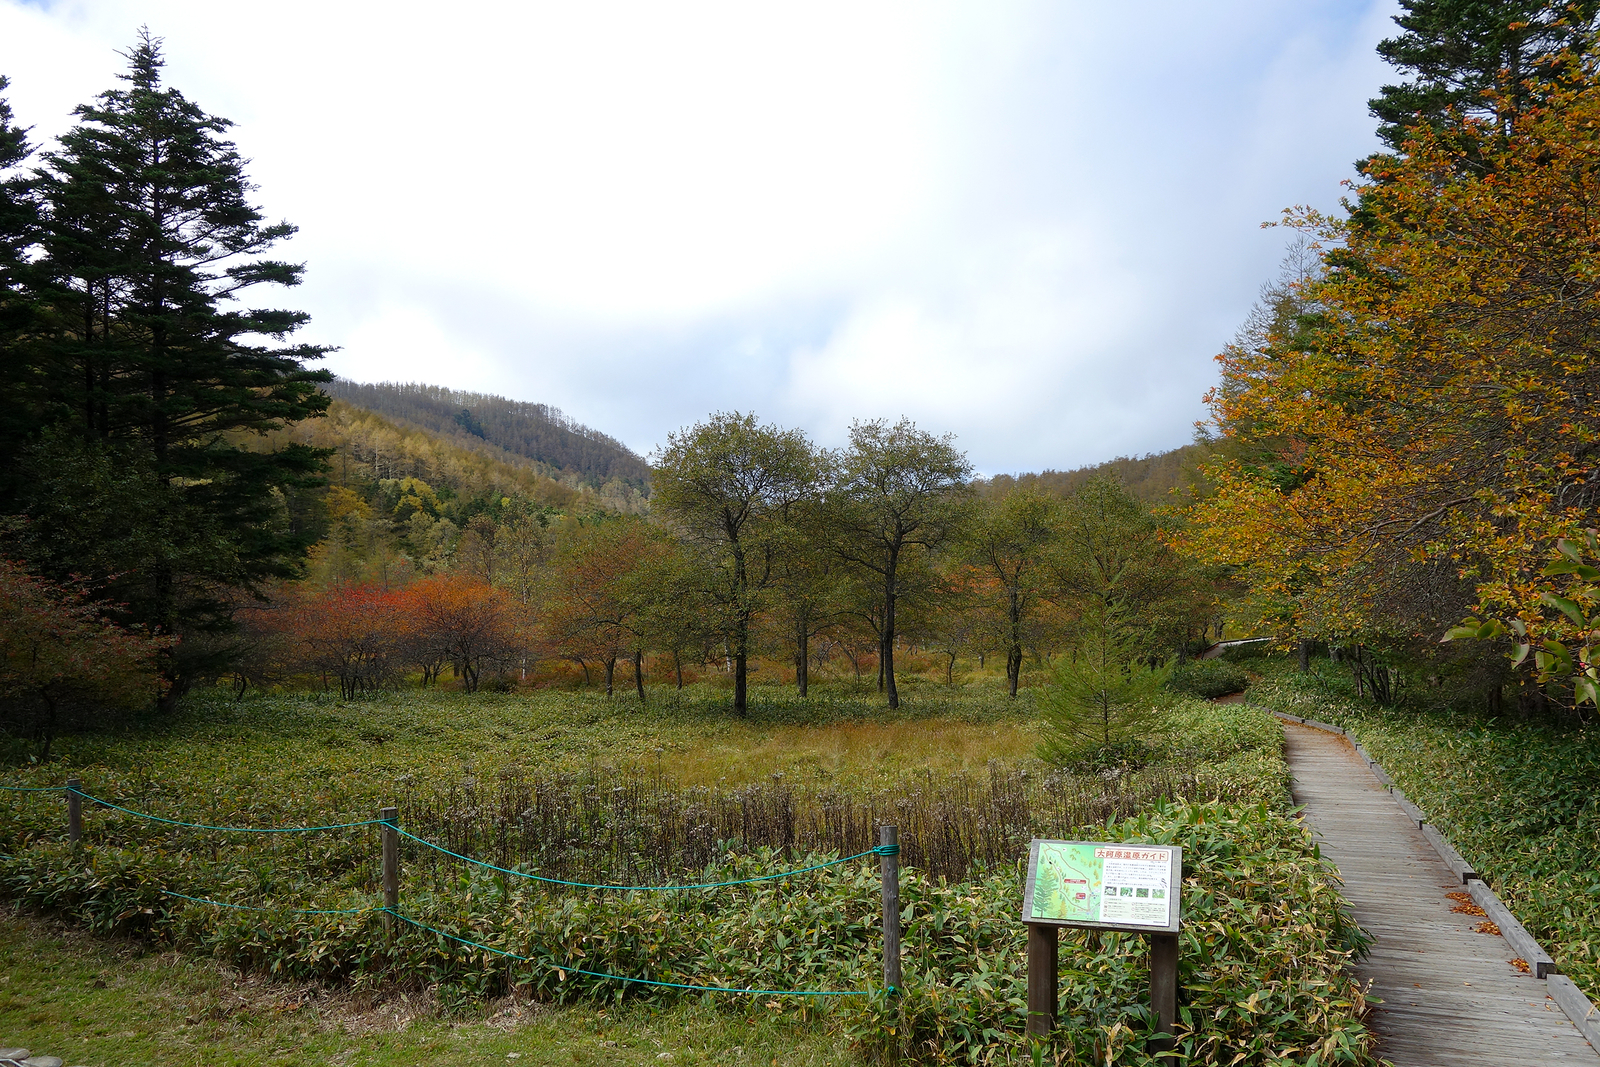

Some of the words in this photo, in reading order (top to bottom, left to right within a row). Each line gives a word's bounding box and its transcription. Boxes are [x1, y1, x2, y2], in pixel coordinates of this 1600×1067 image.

[1097, 850, 1166, 860] 大阿原湿原ガイド
